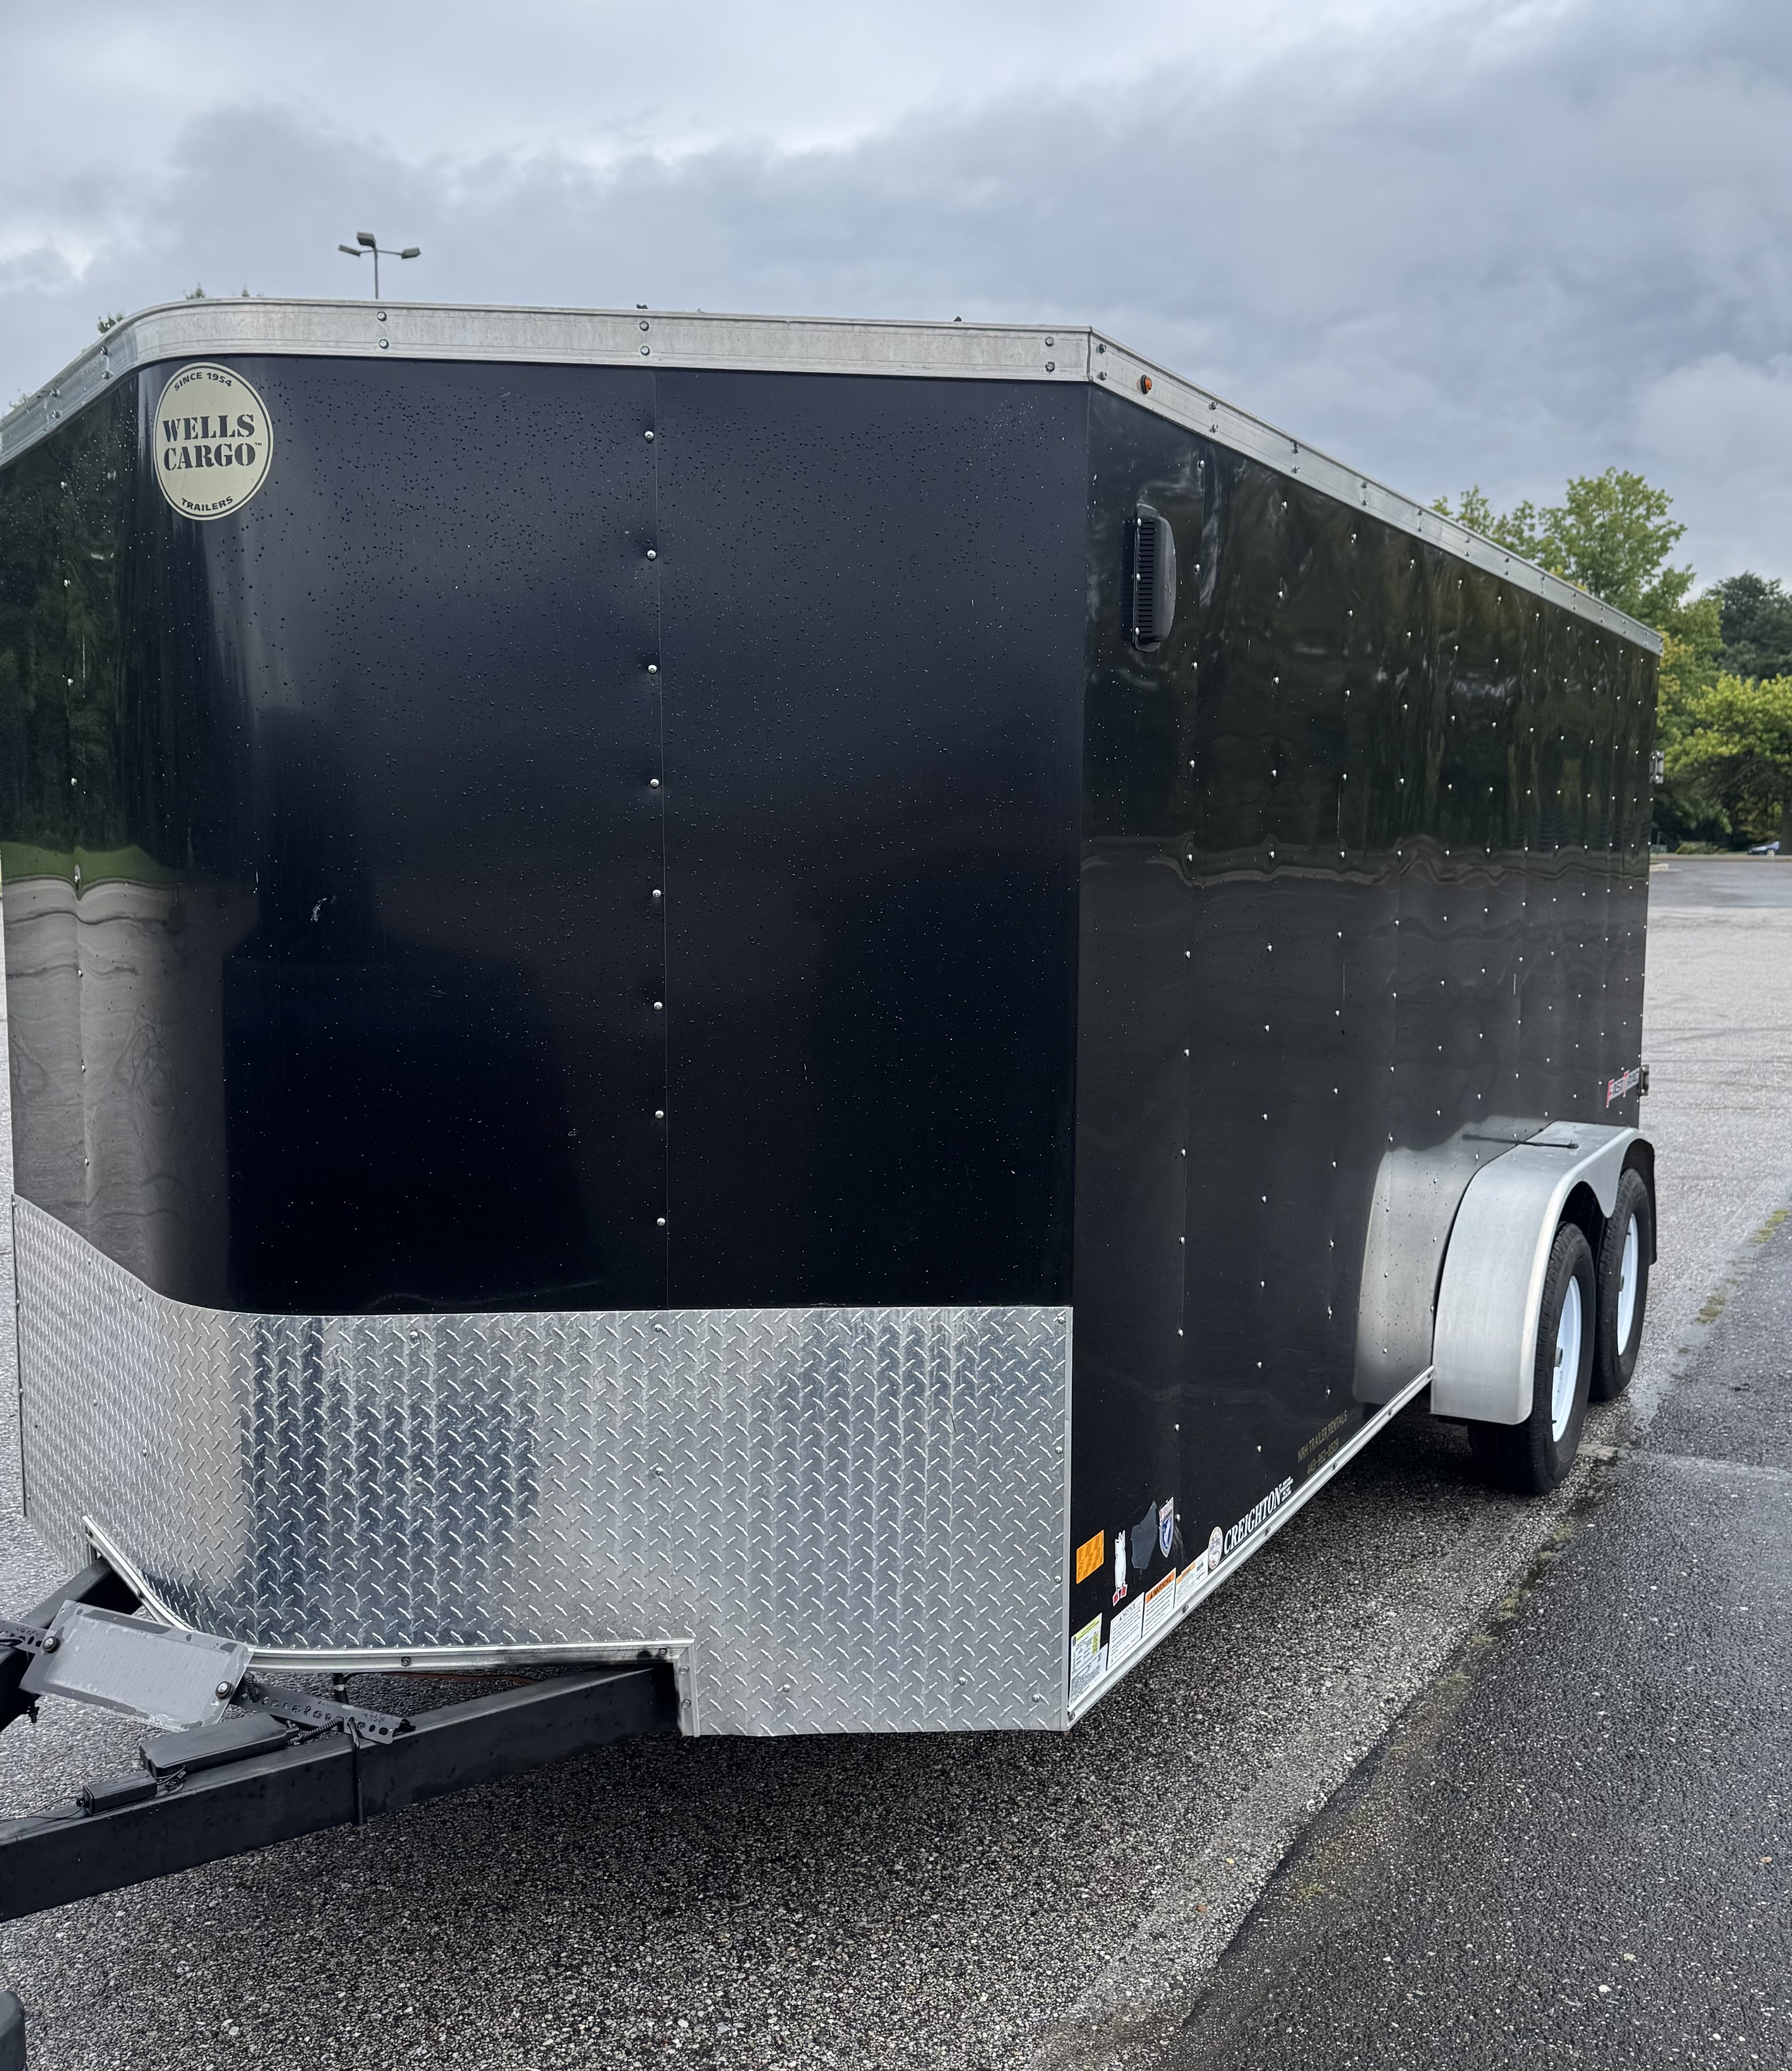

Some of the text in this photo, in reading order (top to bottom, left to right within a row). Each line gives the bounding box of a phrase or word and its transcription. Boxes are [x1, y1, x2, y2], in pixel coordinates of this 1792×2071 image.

[174, 372, 232, 391] SINCE 1954
[162, 414, 255, 442] WELLS
[164, 443, 256, 471] CARGO
[181, 495, 233, 511] TRAILERS
[1309, 1426, 1328, 1453] TRAILER
[1327, 1409, 1347, 1437] RENTALS
[1224, 1483, 1282, 1555] CREIGHTON
